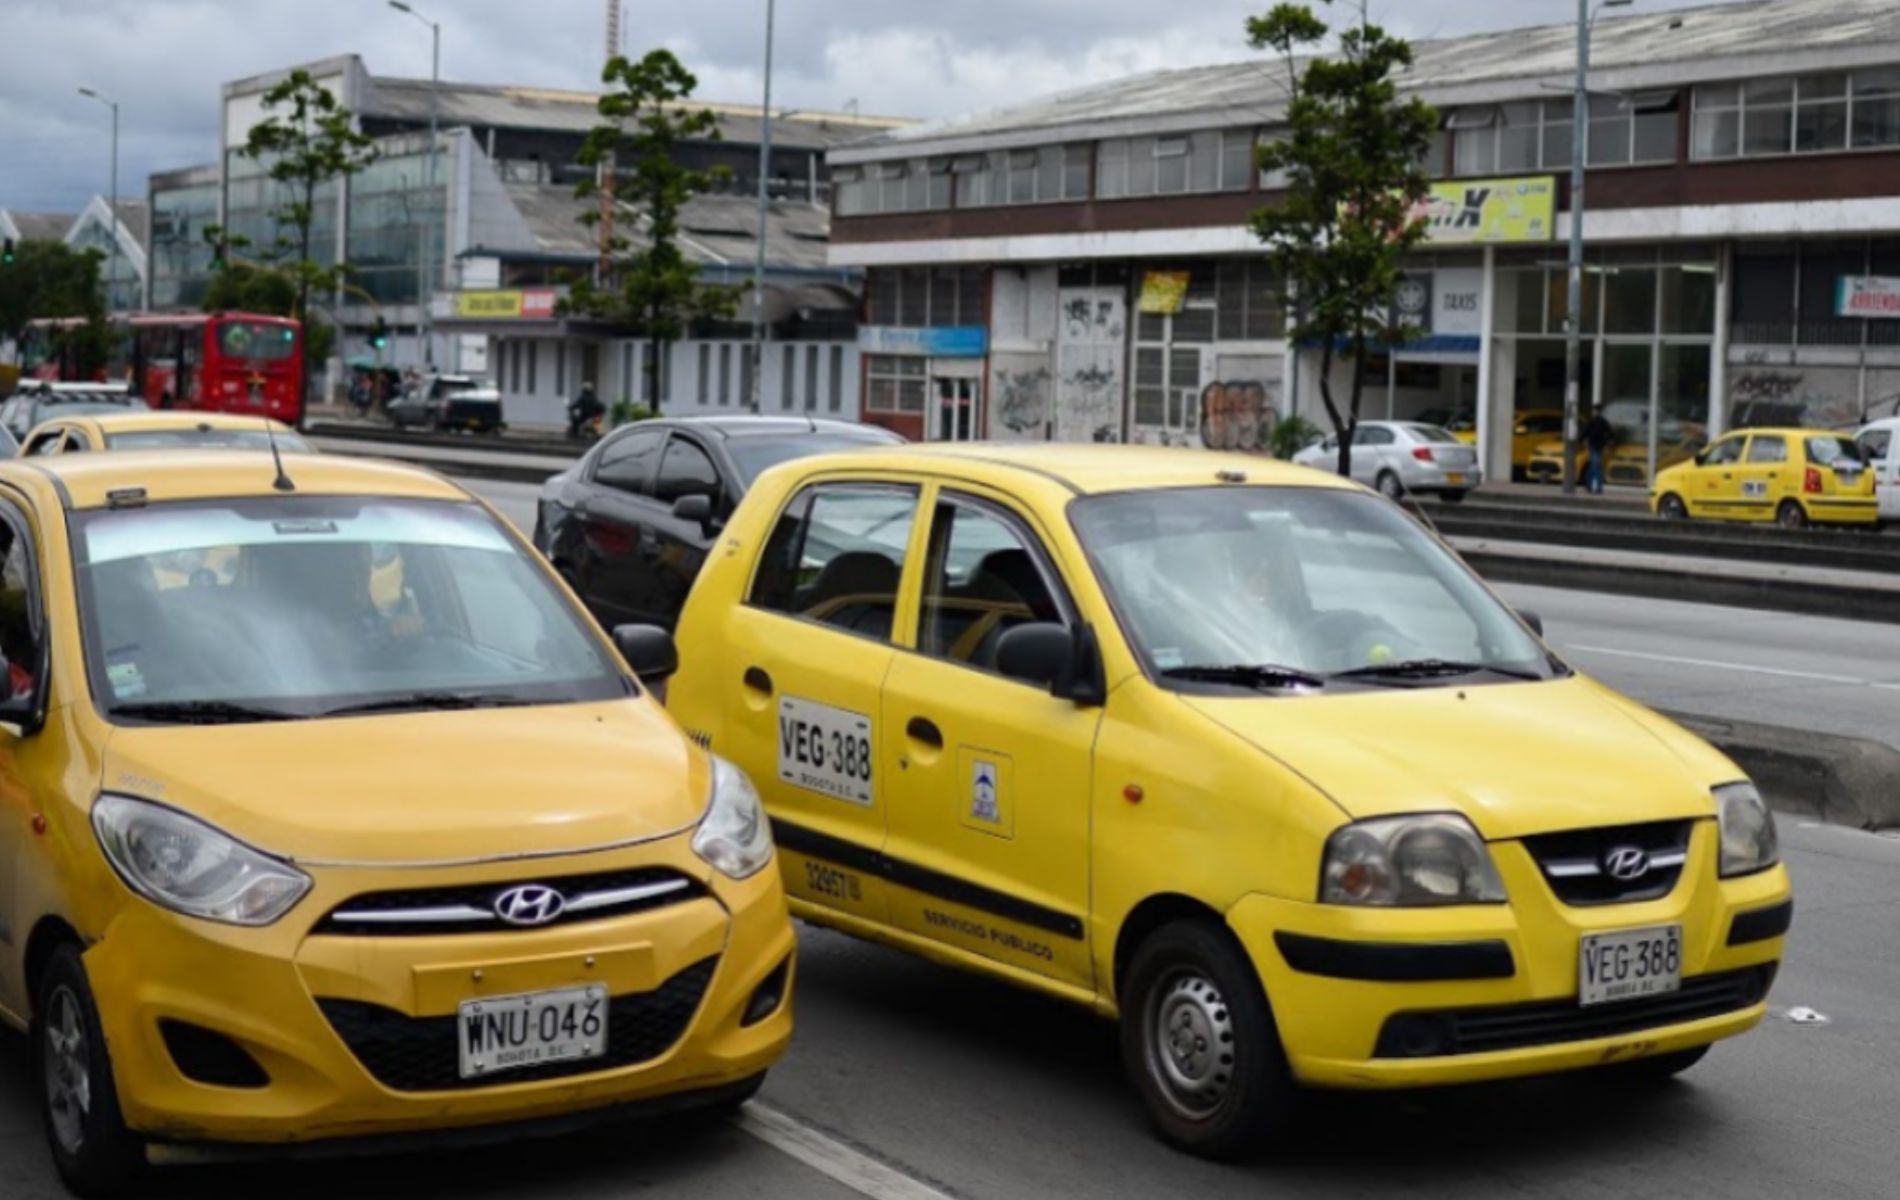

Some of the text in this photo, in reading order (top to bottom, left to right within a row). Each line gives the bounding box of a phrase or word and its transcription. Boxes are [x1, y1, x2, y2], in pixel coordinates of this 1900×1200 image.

[1443, 292, 1478, 311] TAXIS
[923, 907, 1055, 961] SERVICIO PUBLICO
